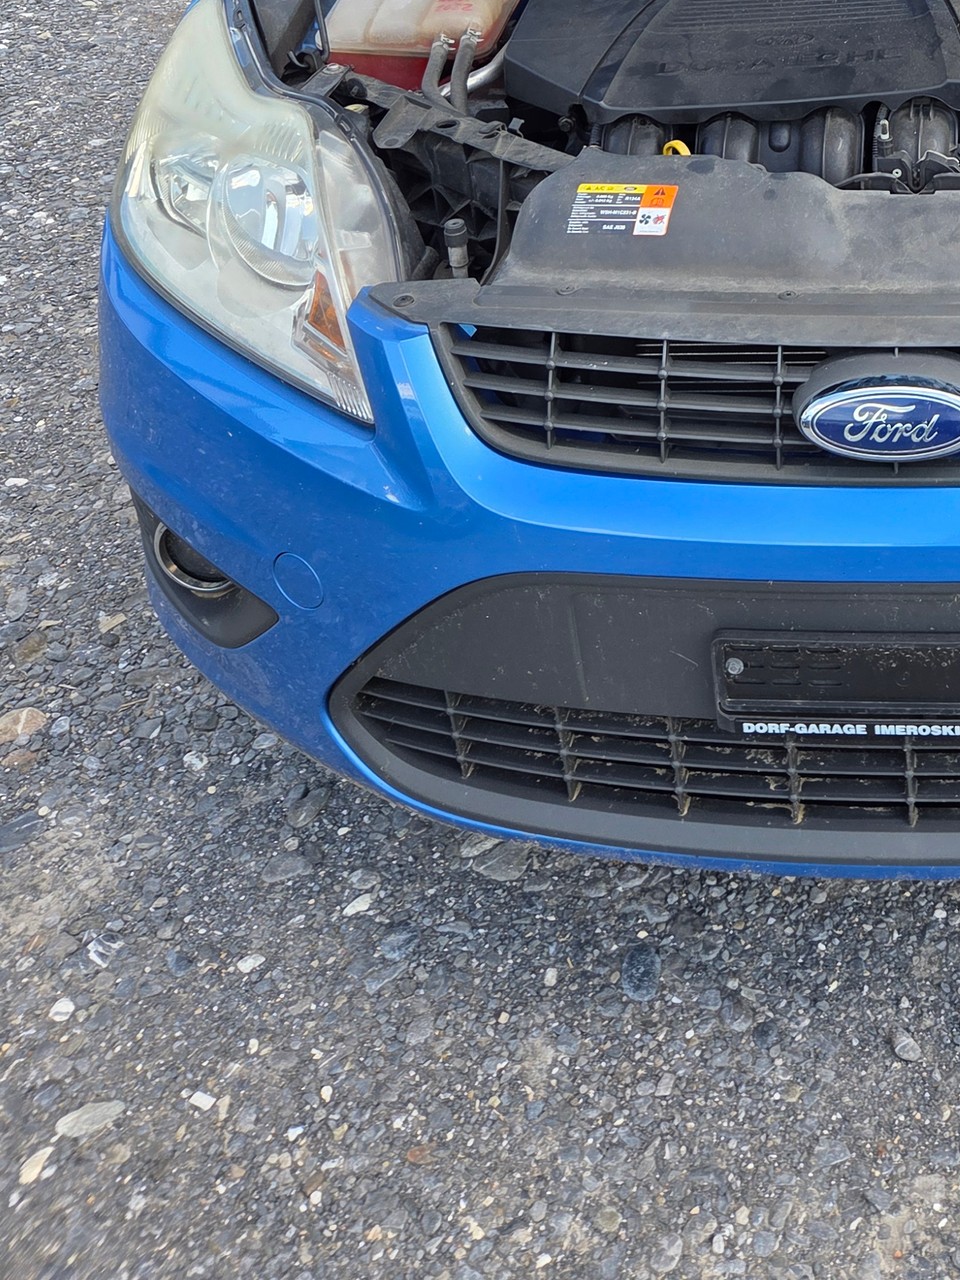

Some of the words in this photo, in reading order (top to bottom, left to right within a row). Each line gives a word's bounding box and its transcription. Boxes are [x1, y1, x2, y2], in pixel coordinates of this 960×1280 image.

[843, 402, 939, 443] Ford
[742, 722, 867, 735] DORF-GARAGE
[874, 724, 960, 736] IMEROSKI
